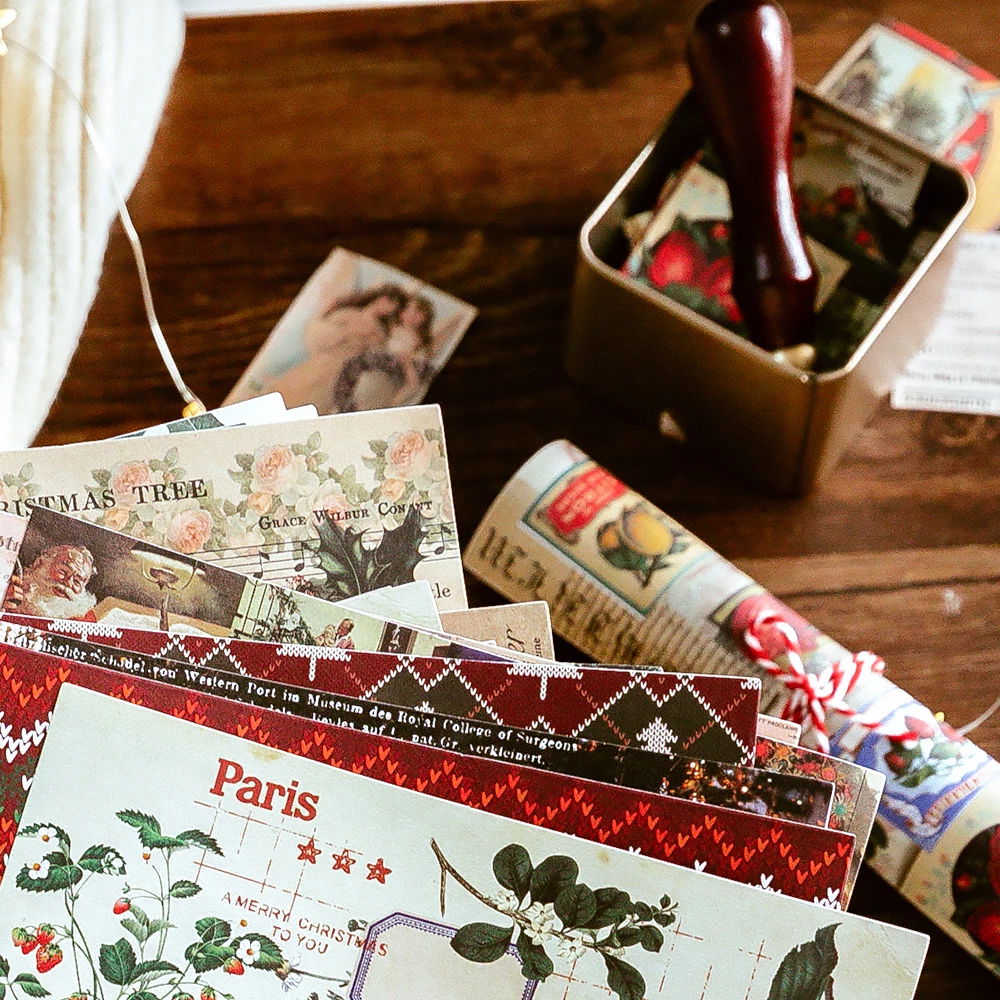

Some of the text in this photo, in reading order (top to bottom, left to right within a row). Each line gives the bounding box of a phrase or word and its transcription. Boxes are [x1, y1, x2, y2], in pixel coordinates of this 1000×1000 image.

[132, 478, 208, 505] TREE
[258, 515, 308, 530] GRACE
[313, 508, 370, 523] WILBUR
[185, 669, 240, 692] Western
[248, 682, 276, 698] Port
[308, 691, 363, 715] Museum
[397, 710, 436, 730] Royal
[442, 719, 492, 738] College
[498, 729, 512, 741] of
[516, 730, 579, 753] Surgeons
[209, 757, 319, 821] Paris
[221, 892, 389, 957] A MERRY CHRISTMAS
[271, 924, 329, 955] TO YOU
